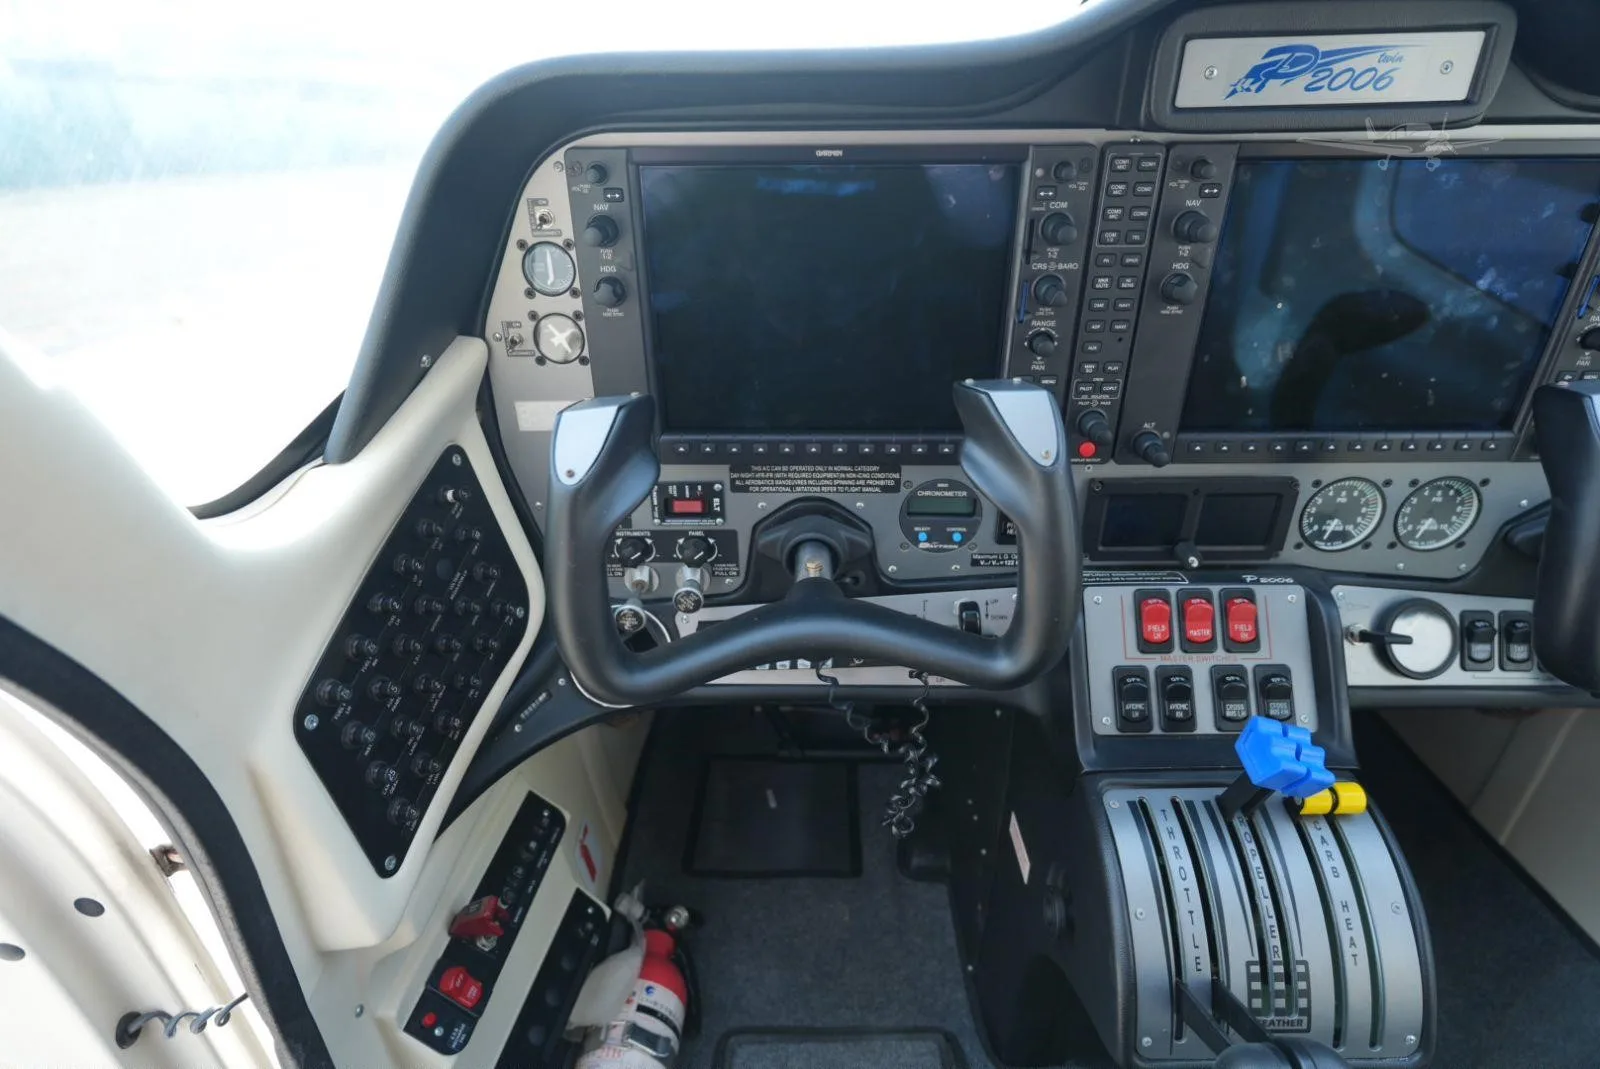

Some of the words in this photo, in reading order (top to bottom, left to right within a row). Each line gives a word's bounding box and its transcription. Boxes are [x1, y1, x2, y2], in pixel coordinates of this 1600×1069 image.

[1376, 51, 1405, 64] twin
[1303, 67, 1401, 92] 2006
[593, 203, 609, 211] NAV
[1050, 201, 1068, 209] COM
[600, 265, 617, 273] HDG
[713, 498, 721, 512] ELT
[391, 685, 398, 693] 5
[1313, 820, 1340, 878] CARB
[1160, 809, 1202, 972] THROTTLE
[1238, 816, 1281, 958] ROPELLER
[1341, 900, 1358, 966] HEAT
[1262, 1019, 1304, 1027] EATHER
